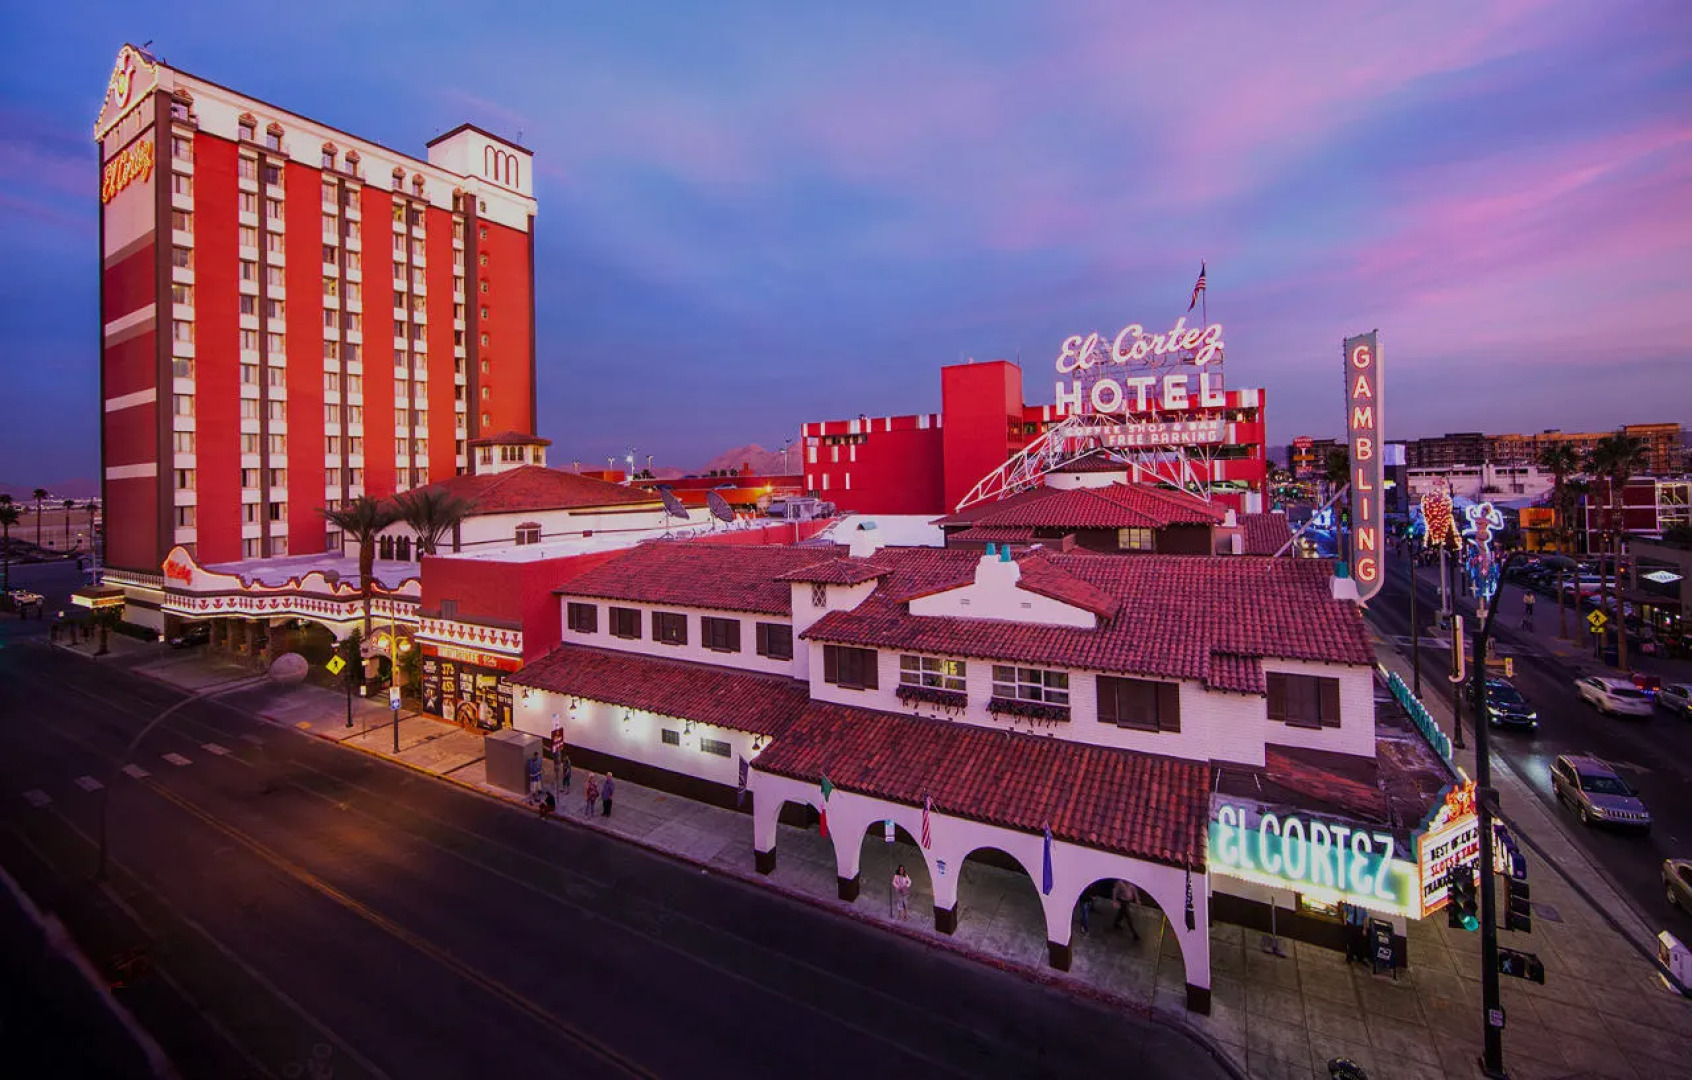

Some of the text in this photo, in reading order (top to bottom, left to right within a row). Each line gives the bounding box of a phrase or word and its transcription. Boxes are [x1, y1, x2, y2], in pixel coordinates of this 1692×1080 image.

[1055, 316, 1225, 374] El Cortez
[1055, 372, 1226, 416] HOTEL
[1108, 430, 1218, 446] FREE PARKING
[1128, 423, 1166, 433] SHOP
[1352, 345, 1376, 582] GAMBLING
[1218, 804, 1255, 871] EL
[1259, 812, 1397, 901] CORTEZ
[1430, 841, 1450, 861] BEST
[1430, 854, 1455, 877] SLOTS
